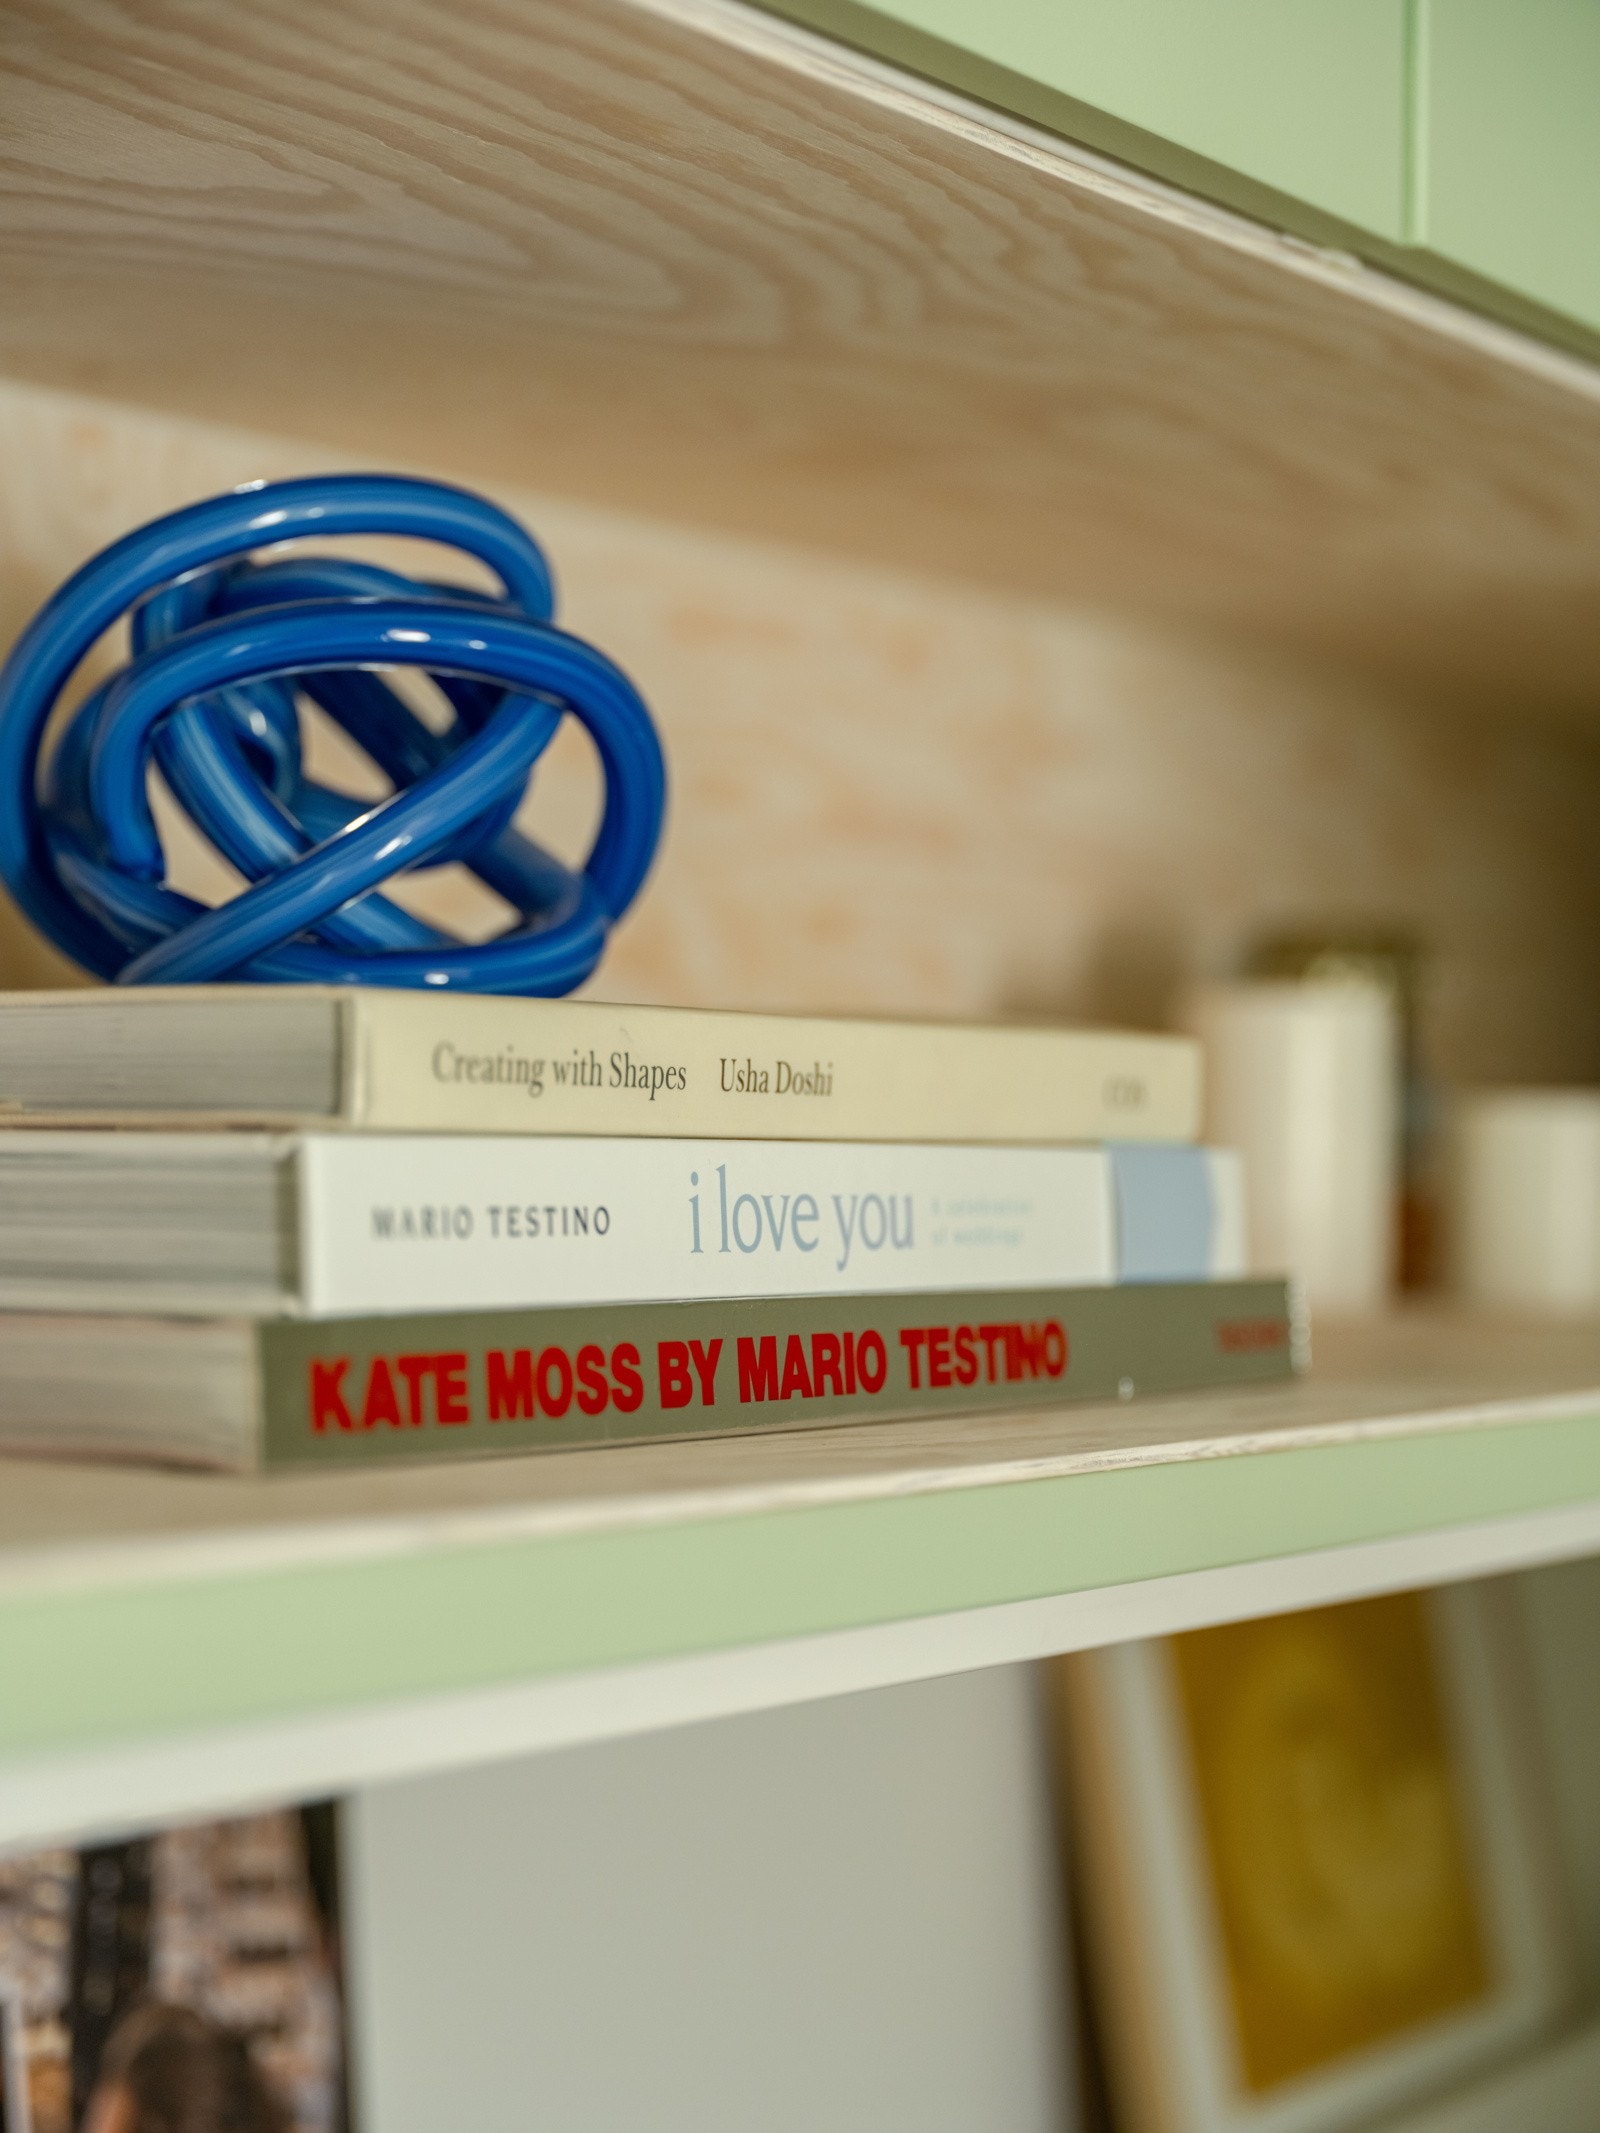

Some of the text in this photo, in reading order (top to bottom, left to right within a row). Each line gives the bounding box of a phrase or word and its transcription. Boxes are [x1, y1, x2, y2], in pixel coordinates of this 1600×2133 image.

[431, 1041, 688, 1100] Creating with Shapes
[720, 1057, 834, 1098] Usha Doshi
[372, 1204, 611, 1239] MARIO TESTINO
[689, 1163, 914, 1272] i love you
[311, 1320, 1068, 1432] KATE MOSS BY MARIO TESTINO
